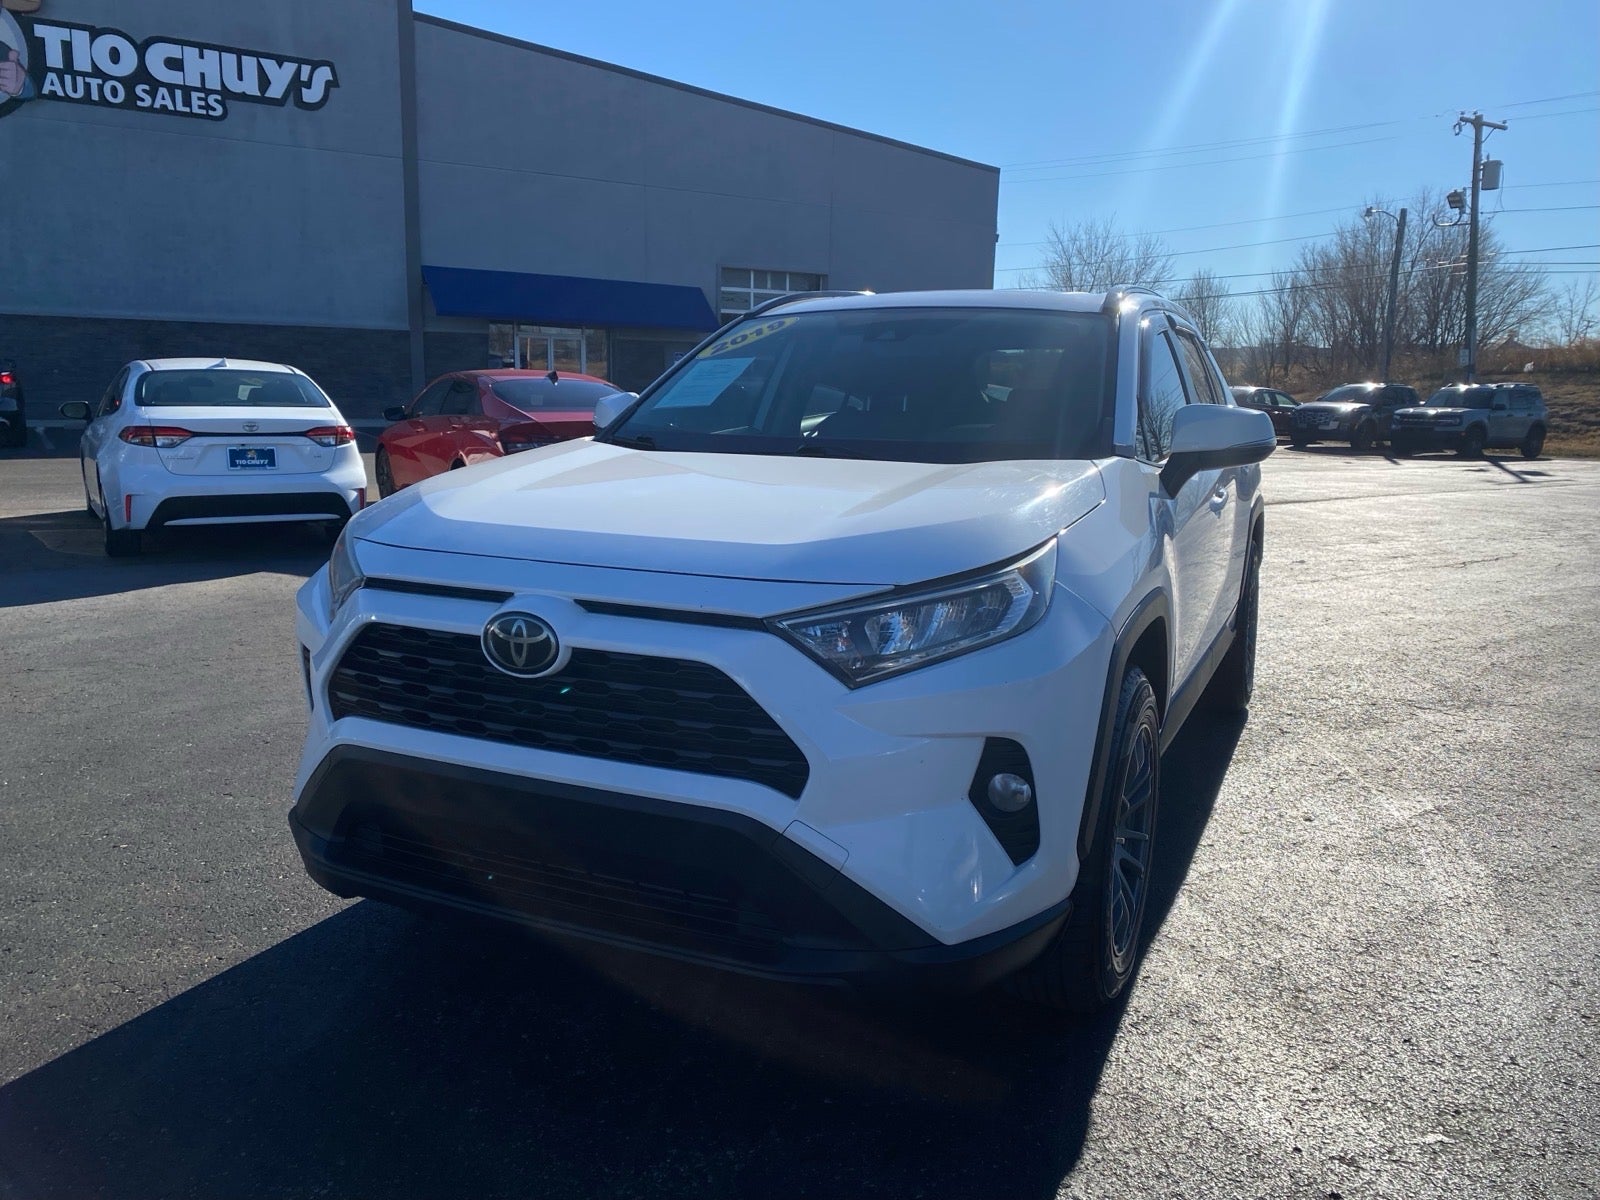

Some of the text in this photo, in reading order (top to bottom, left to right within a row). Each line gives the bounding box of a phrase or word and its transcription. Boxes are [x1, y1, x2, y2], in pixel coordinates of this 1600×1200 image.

[33, 23, 333, 104] TIO CHUY'S
[41, 72, 224, 117] AUTO SALES
[710, 320, 785, 355] 2019
